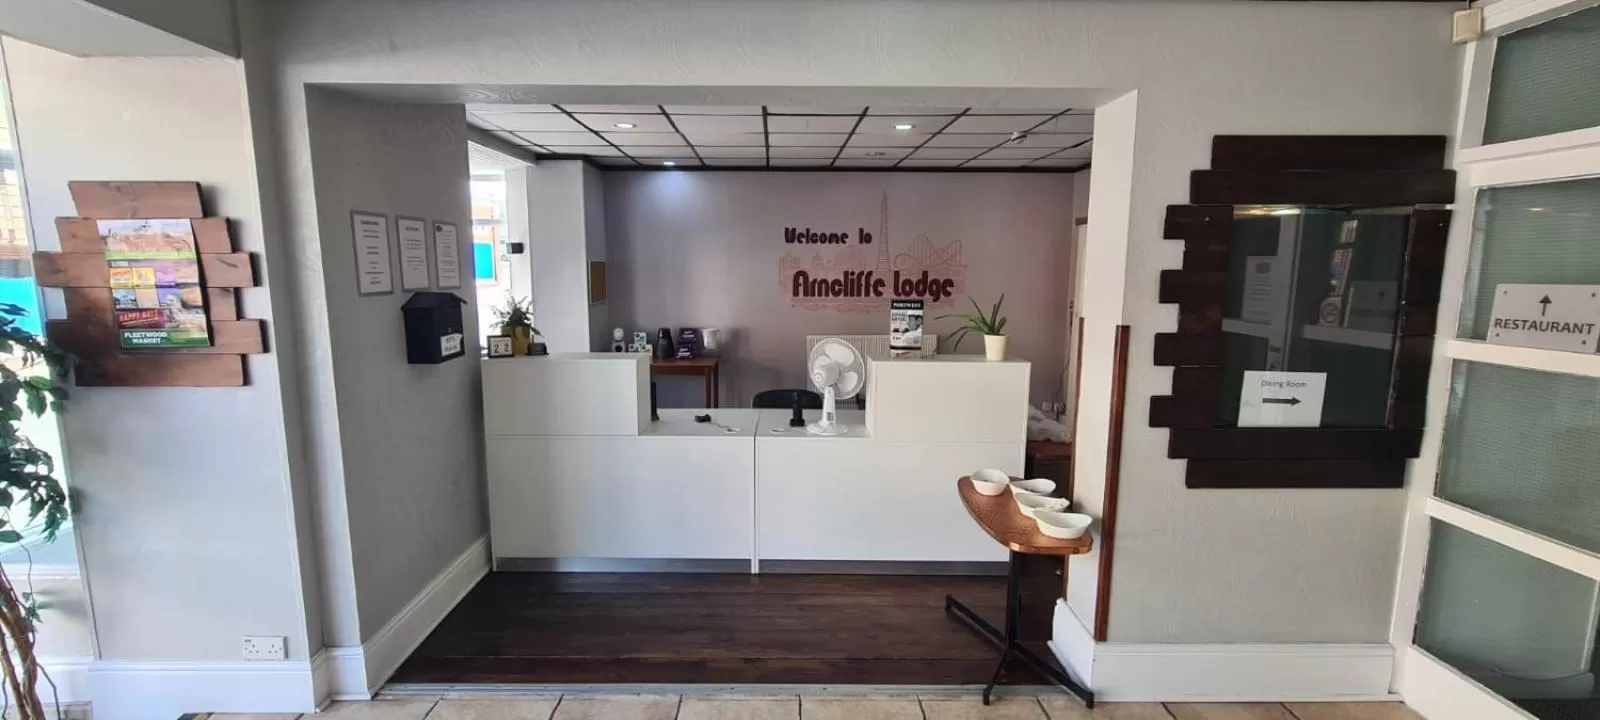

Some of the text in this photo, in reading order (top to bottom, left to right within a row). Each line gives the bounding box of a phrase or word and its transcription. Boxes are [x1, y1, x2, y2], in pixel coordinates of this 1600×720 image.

[784, 227, 849, 244] Welcome
[792, 270, 886, 297] Arncliffe
[1494, 318, 1596, 335] RESTAURANT
[1261, 380, 1307, 388] Dining Room
